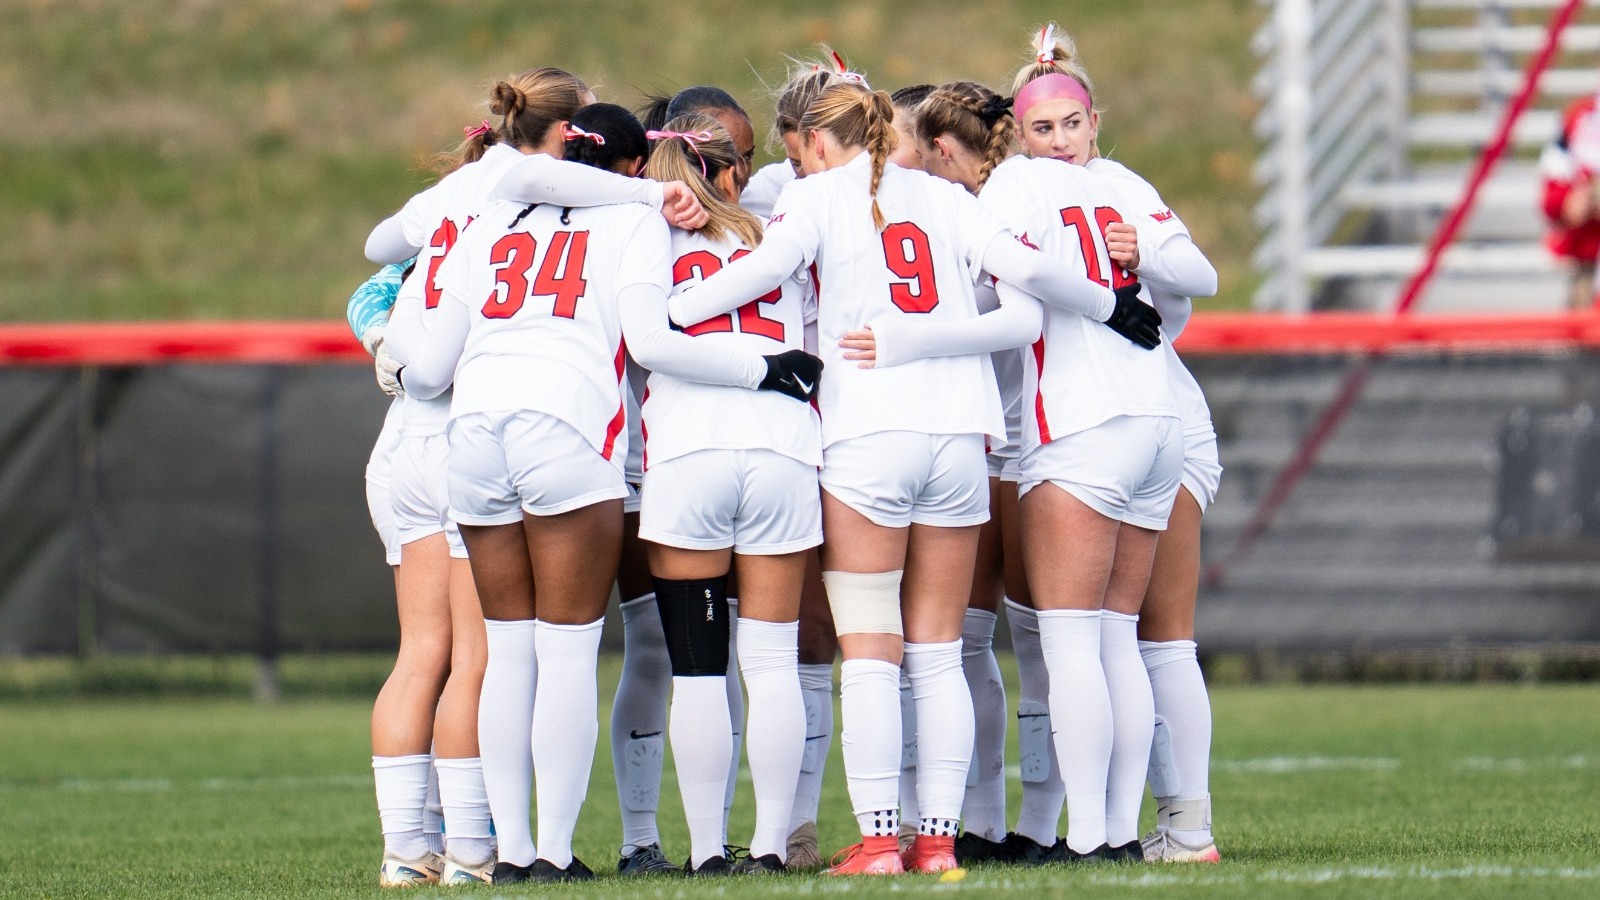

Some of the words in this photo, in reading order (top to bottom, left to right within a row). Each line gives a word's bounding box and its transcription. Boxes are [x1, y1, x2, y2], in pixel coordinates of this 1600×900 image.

[425, 215, 475, 309] 2
[480, 229, 590, 320] 34
[881, 220, 940, 314] 9
